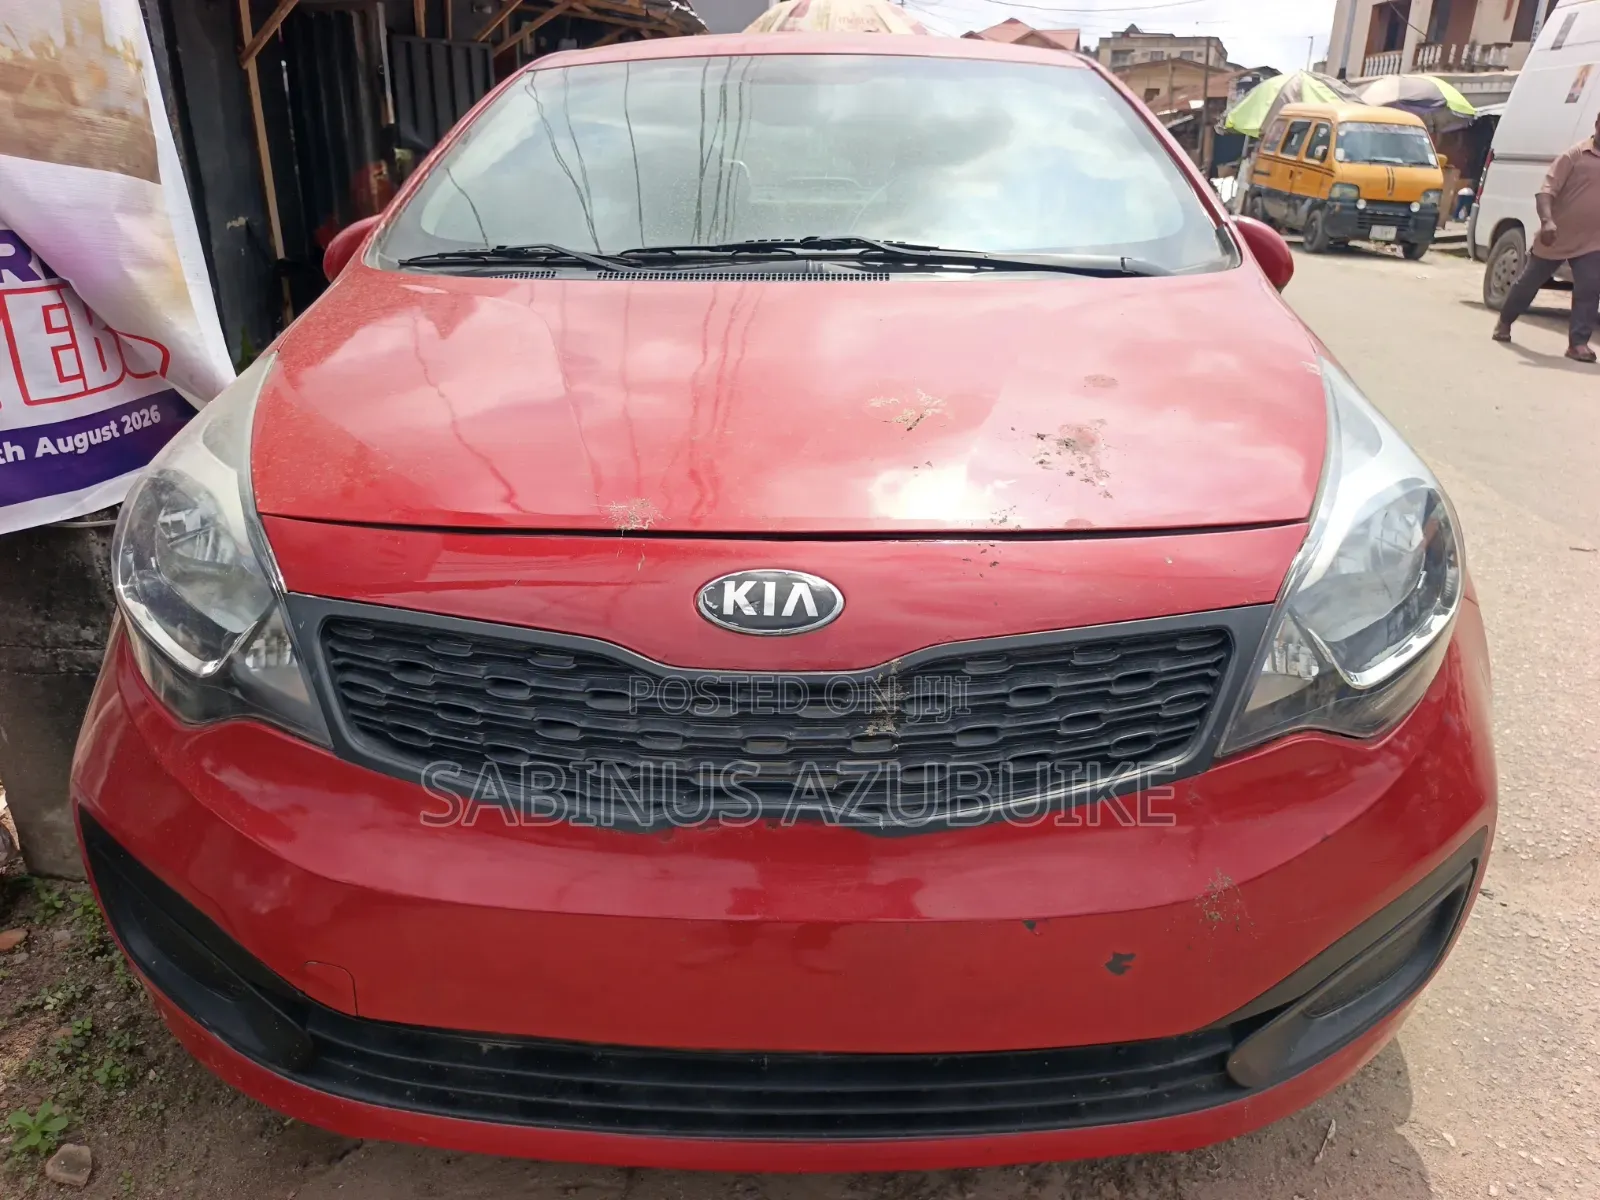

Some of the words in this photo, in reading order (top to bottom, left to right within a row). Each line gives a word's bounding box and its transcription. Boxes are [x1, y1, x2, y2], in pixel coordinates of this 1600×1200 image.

[34, 420, 120, 458] August
[121, 404, 161, 435] 2026
[722, 580, 819, 617] KIA
